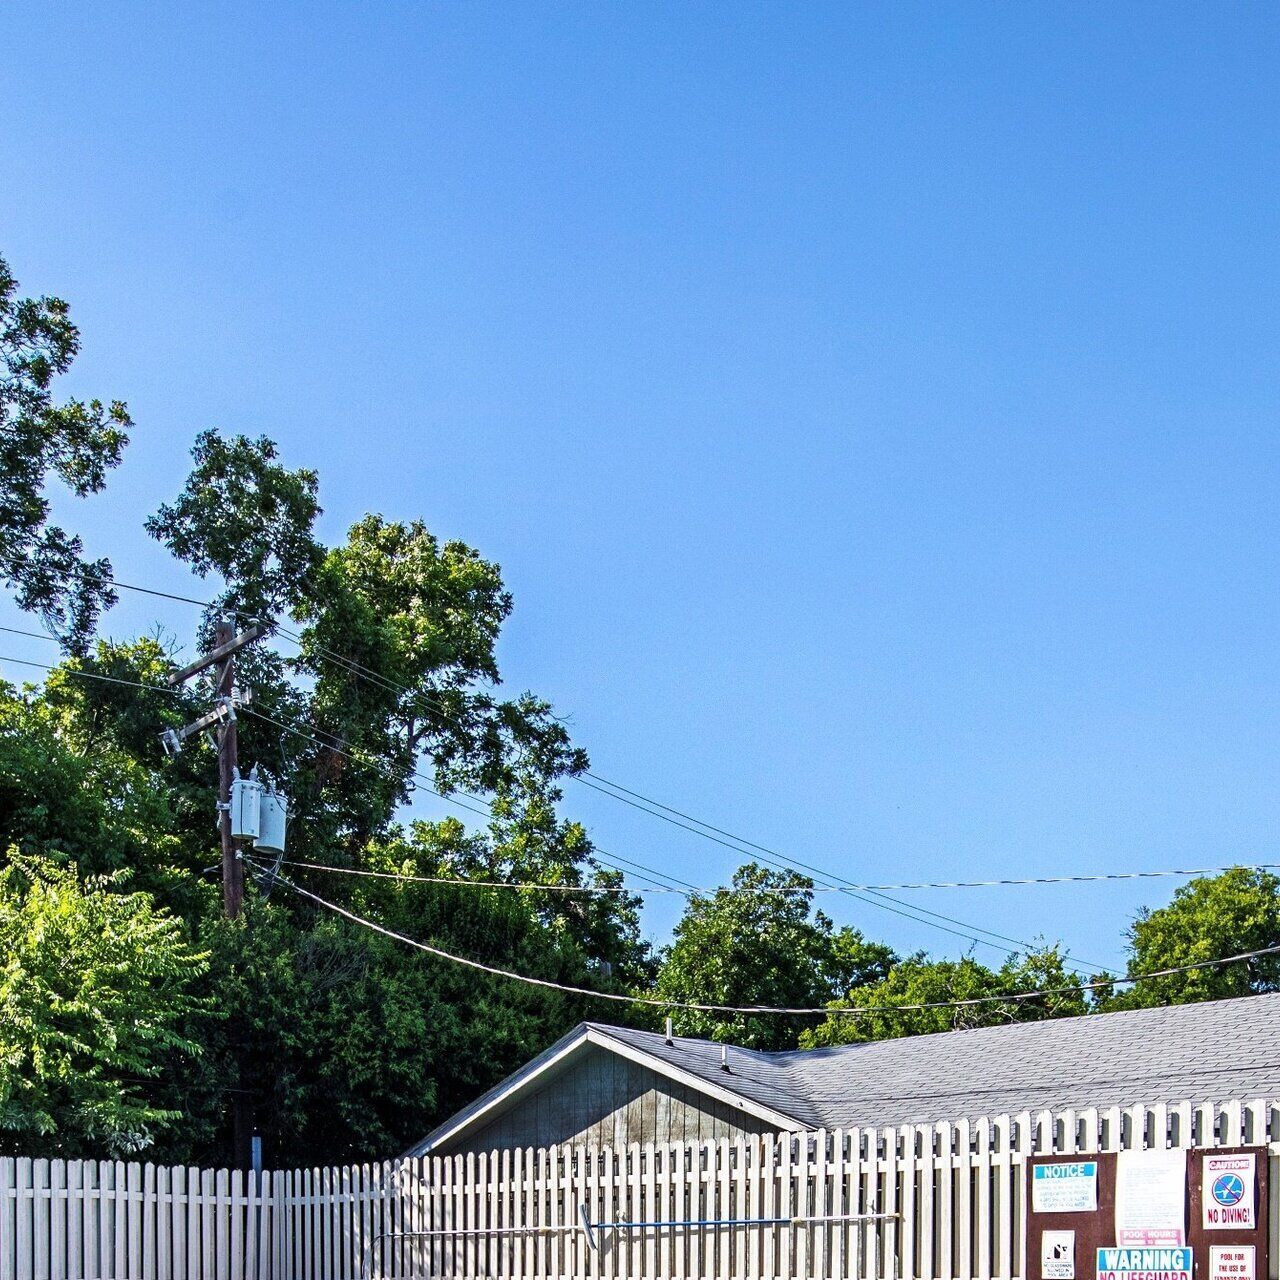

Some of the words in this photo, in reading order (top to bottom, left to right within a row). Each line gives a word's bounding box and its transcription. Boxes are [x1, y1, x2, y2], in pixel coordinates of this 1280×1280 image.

[1044, 1164, 1085, 1178] NOTICE
[1208, 1208, 1218, 1223] NO
[1222, 1208, 1250, 1223] DIVING!
[1123, 1230, 1145, 1239] POOL
[1147, 1230, 1177, 1239] HOURS
[1105, 1249, 1184, 1270] WARNING
